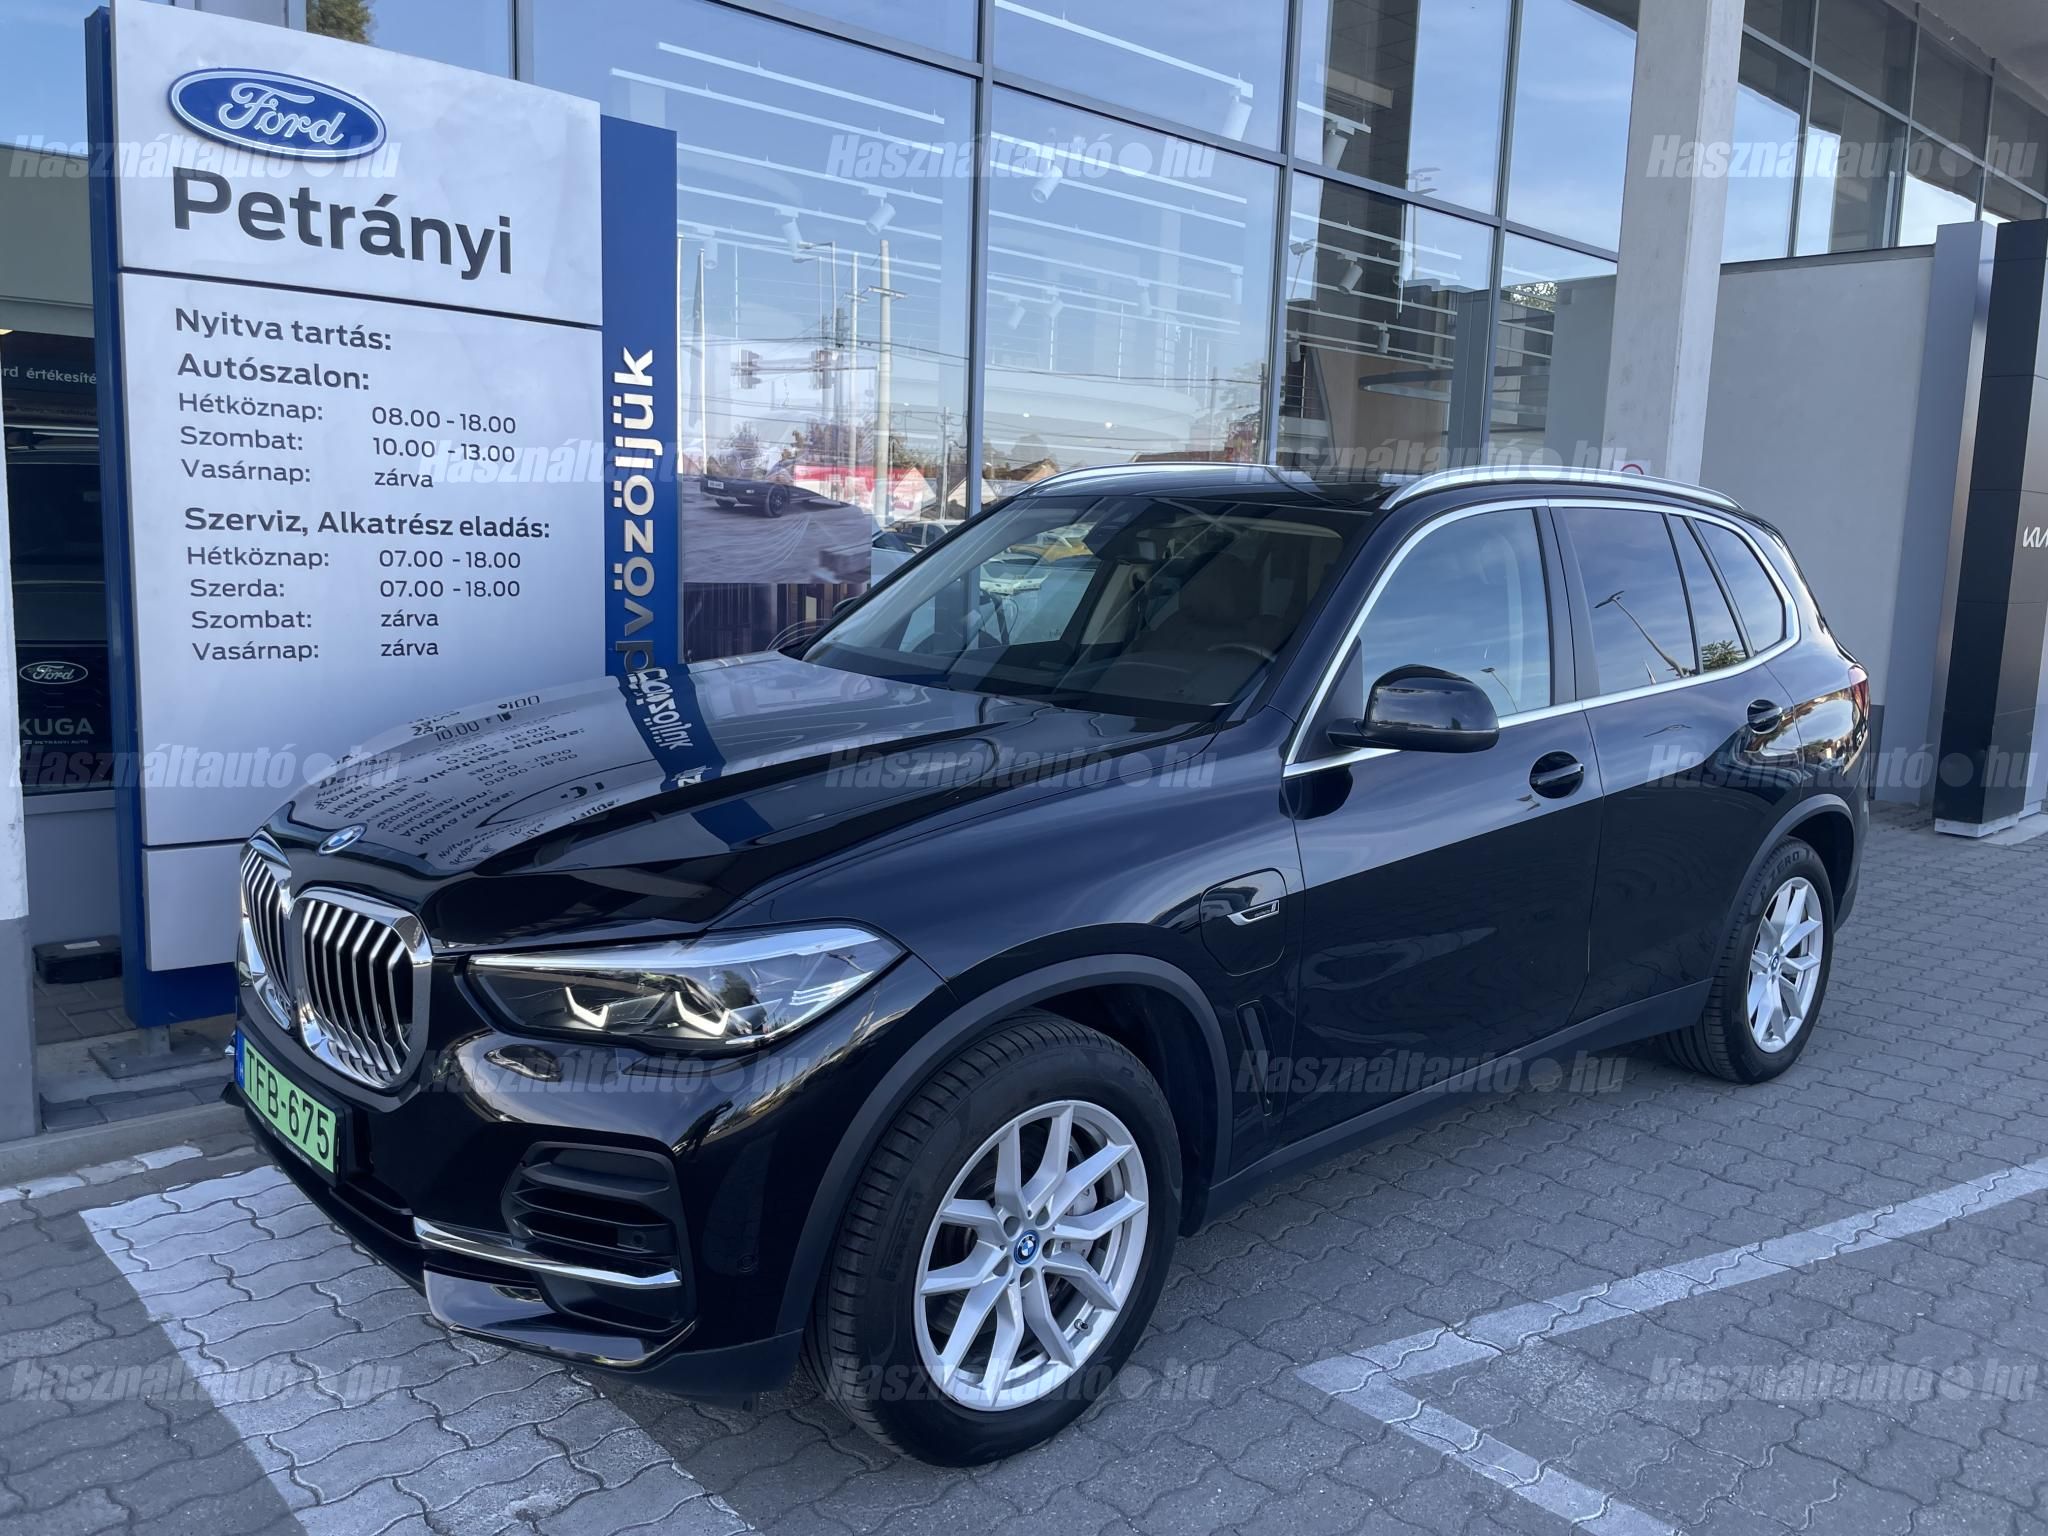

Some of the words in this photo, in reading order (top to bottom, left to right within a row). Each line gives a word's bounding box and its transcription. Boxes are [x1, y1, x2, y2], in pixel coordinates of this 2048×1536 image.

[218, 82, 346, 145] Ford
[173, 166, 512, 281] Petrányi
[175, 308, 284, 341] Nyitva
[290, 320, 392, 351] tartás:
[0, 366, 19, 378] rd
[177, 353, 370, 390] Autószalon:
[178, 392, 324, 424] Hétköznap:
[371, 406, 441, 429] 08.00
[180, 425, 304, 451] Szombat:
[372, 436, 436, 458] 10.00
[180, 458, 312, 486] Vasárnap:
[374, 467, 434, 489] zárva
[184, 507, 309, 537] Szerviz,
[317, 510, 454, 536] Alkatrész
[459, 515, 550, 539] eladás:
[187, 545, 329, 570] Hétköznap:
[379, 549, 444, 568] 07.00
[190, 578, 285, 598] Szerda:
[379, 579, 444, 598] 07.00
[191, 609, 312, 629] Szombat:
[380, 608, 440, 628] zárva
[191, 640, 319, 663] Vasárnap:
[380, 638, 439, 657] zárva
[32, 664, 74, 681] Ford
[20, 717, 95, 736] KUGA
[246, 1046, 330, 1160] TFB-675
